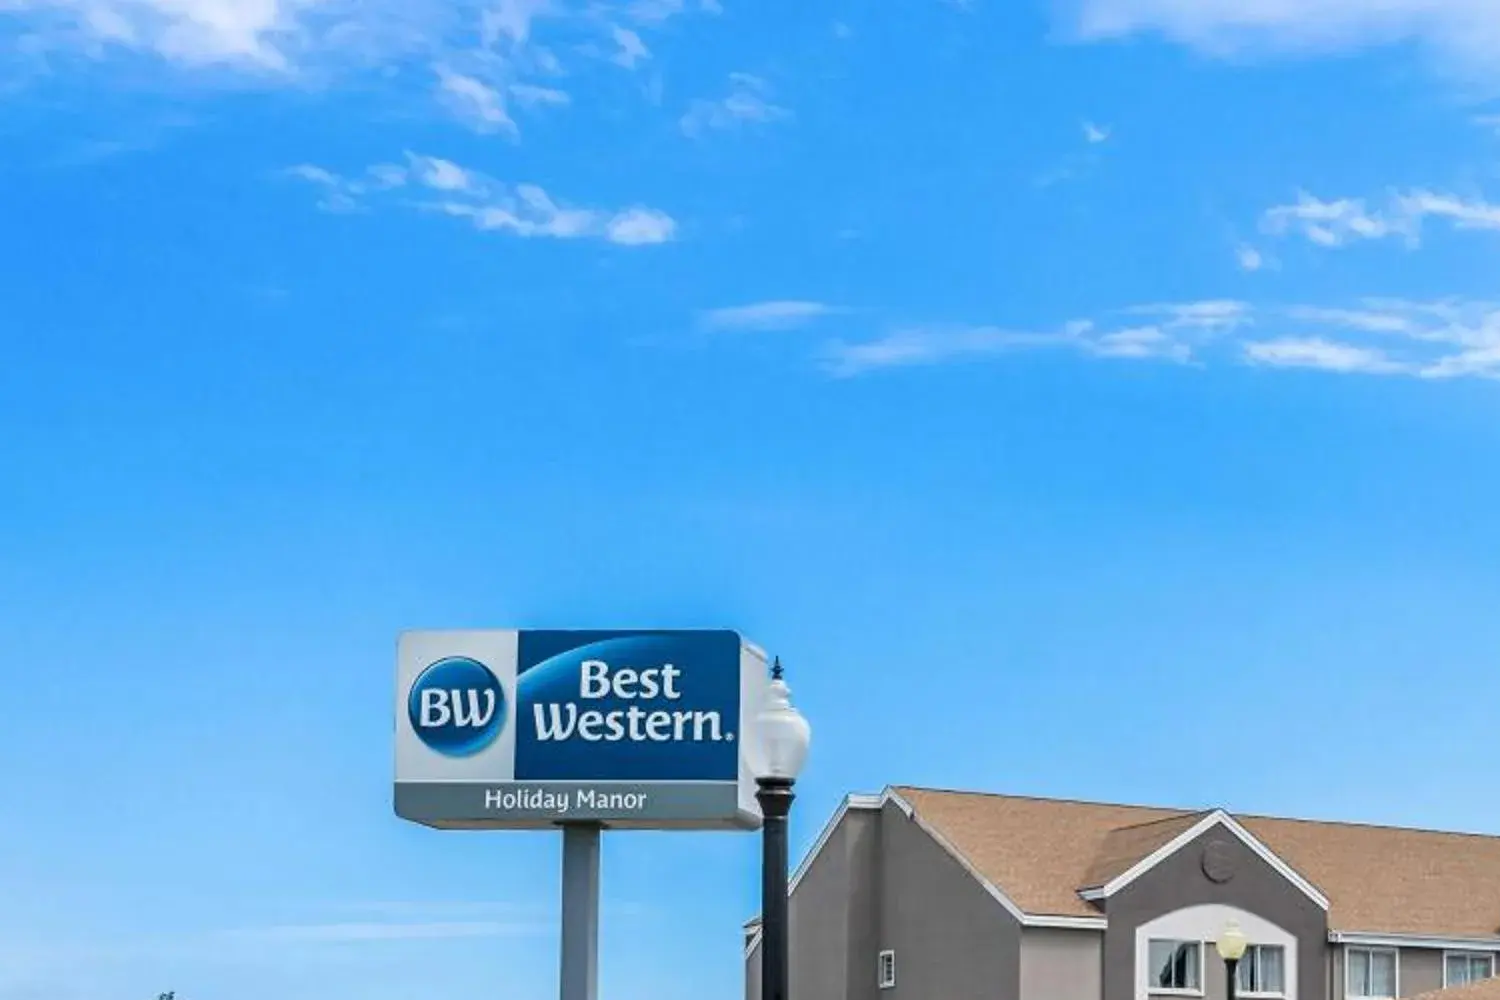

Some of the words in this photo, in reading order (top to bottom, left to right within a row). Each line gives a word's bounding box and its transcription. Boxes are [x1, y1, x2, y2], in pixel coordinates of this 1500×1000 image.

[580, 659, 681, 699] Best
[420, 687, 495, 728] BW
[485, 789, 569, 812] Holiday
[577, 789, 647, 809] Manor
